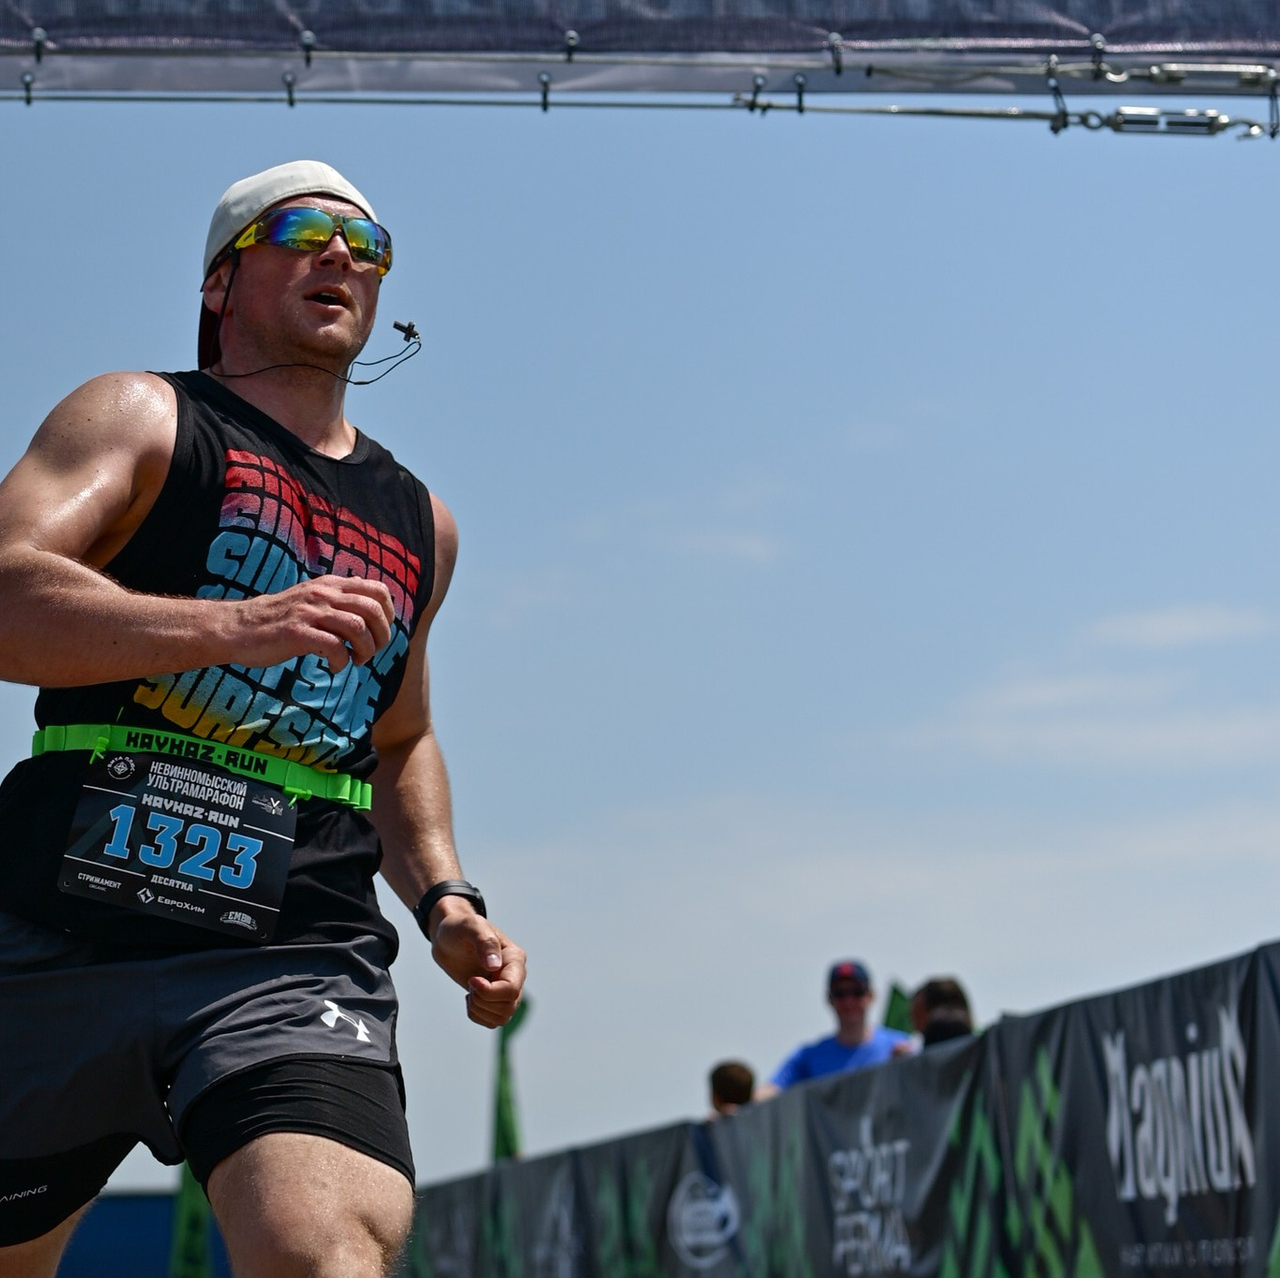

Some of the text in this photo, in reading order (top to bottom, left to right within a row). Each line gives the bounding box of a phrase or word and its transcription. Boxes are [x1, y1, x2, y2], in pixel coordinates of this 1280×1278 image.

[146, 772, 245, 811] УЛЬТРАМАРАФОН
[149, 760, 248, 798] НЕВИННОМЫССКИЙ
[103, 803, 264, 890] 1323
[77, 872, 122, 890] СТРИЖАМЕНТ
[150, 874, 194, 893] ДЕСЯТКА
